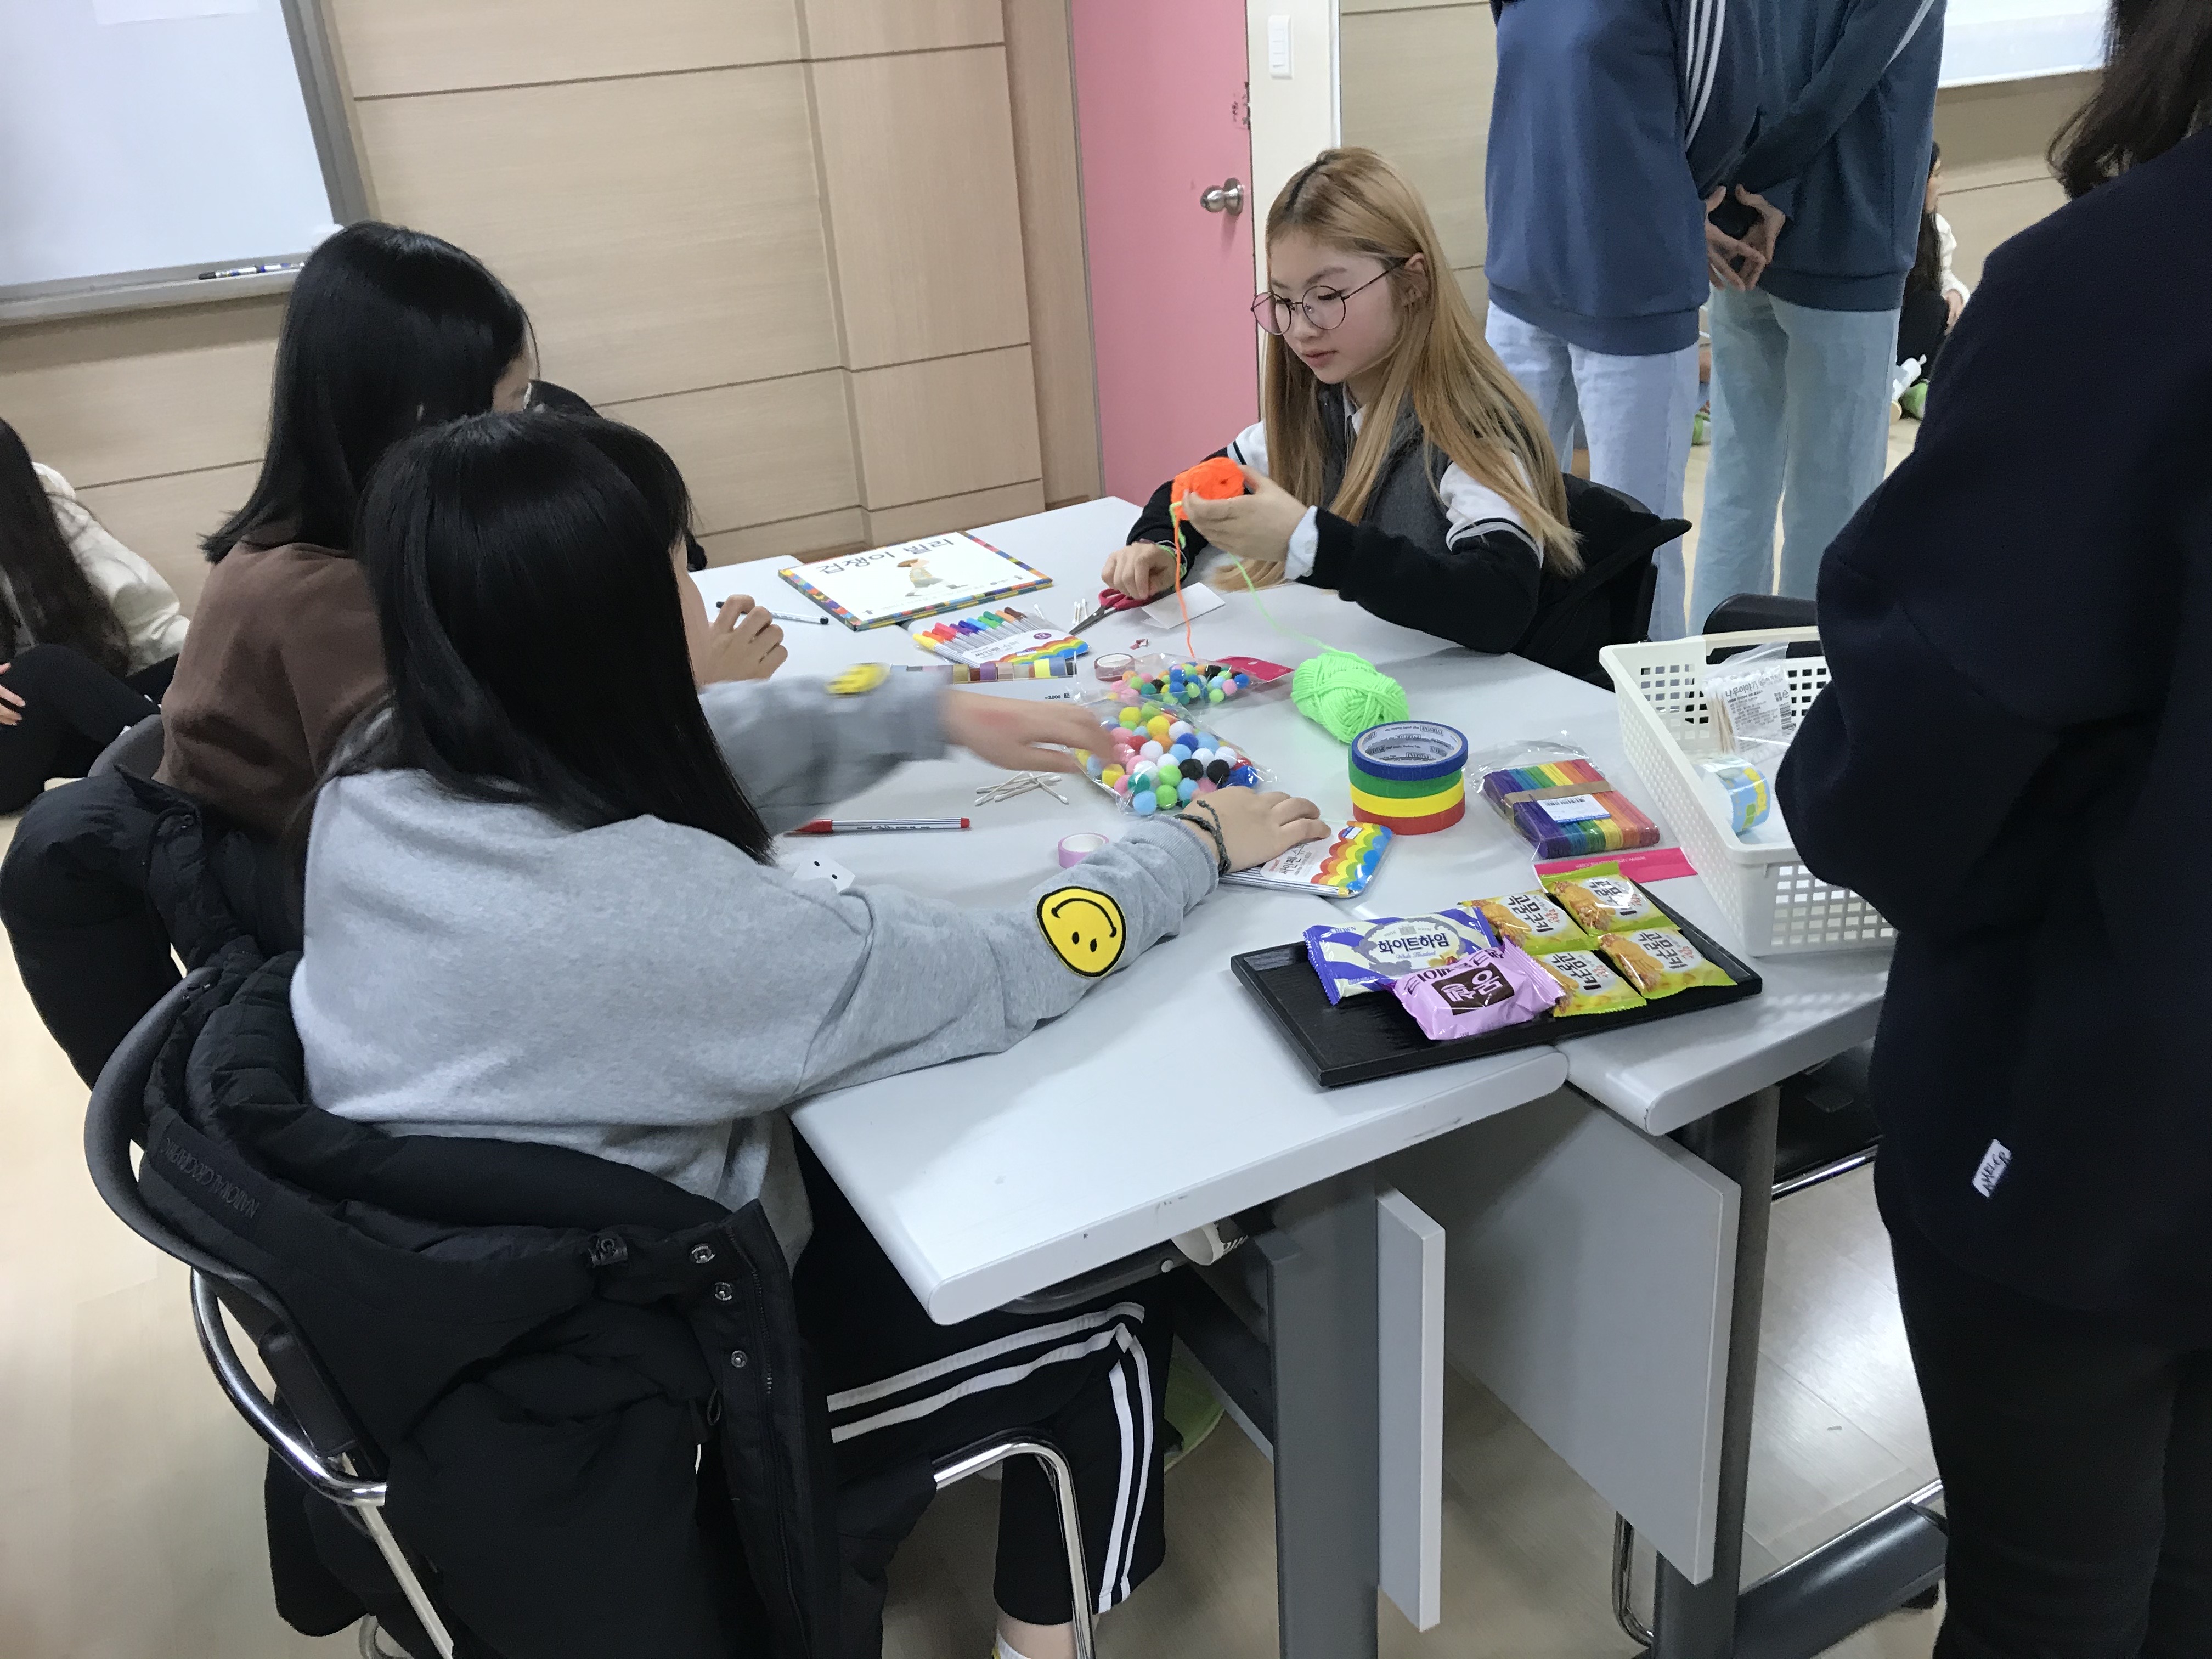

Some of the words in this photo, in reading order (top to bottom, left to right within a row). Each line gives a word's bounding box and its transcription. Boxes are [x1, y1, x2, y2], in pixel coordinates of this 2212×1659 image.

[816, 551, 895, 574] 겁쟁이
[903, 539, 954, 555] 빌리
[1725, 682, 1759, 698] 나무이야기
[1507, 894, 1554, 933] 곡물쿠키
[1378, 932, 1450, 955] 화이트하임
[1638, 932, 1688, 969] 곡물쿠키
[1441, 970, 1503, 1002] 몽쉘
[1551, 952, 1602, 990] 곡물쿠키
